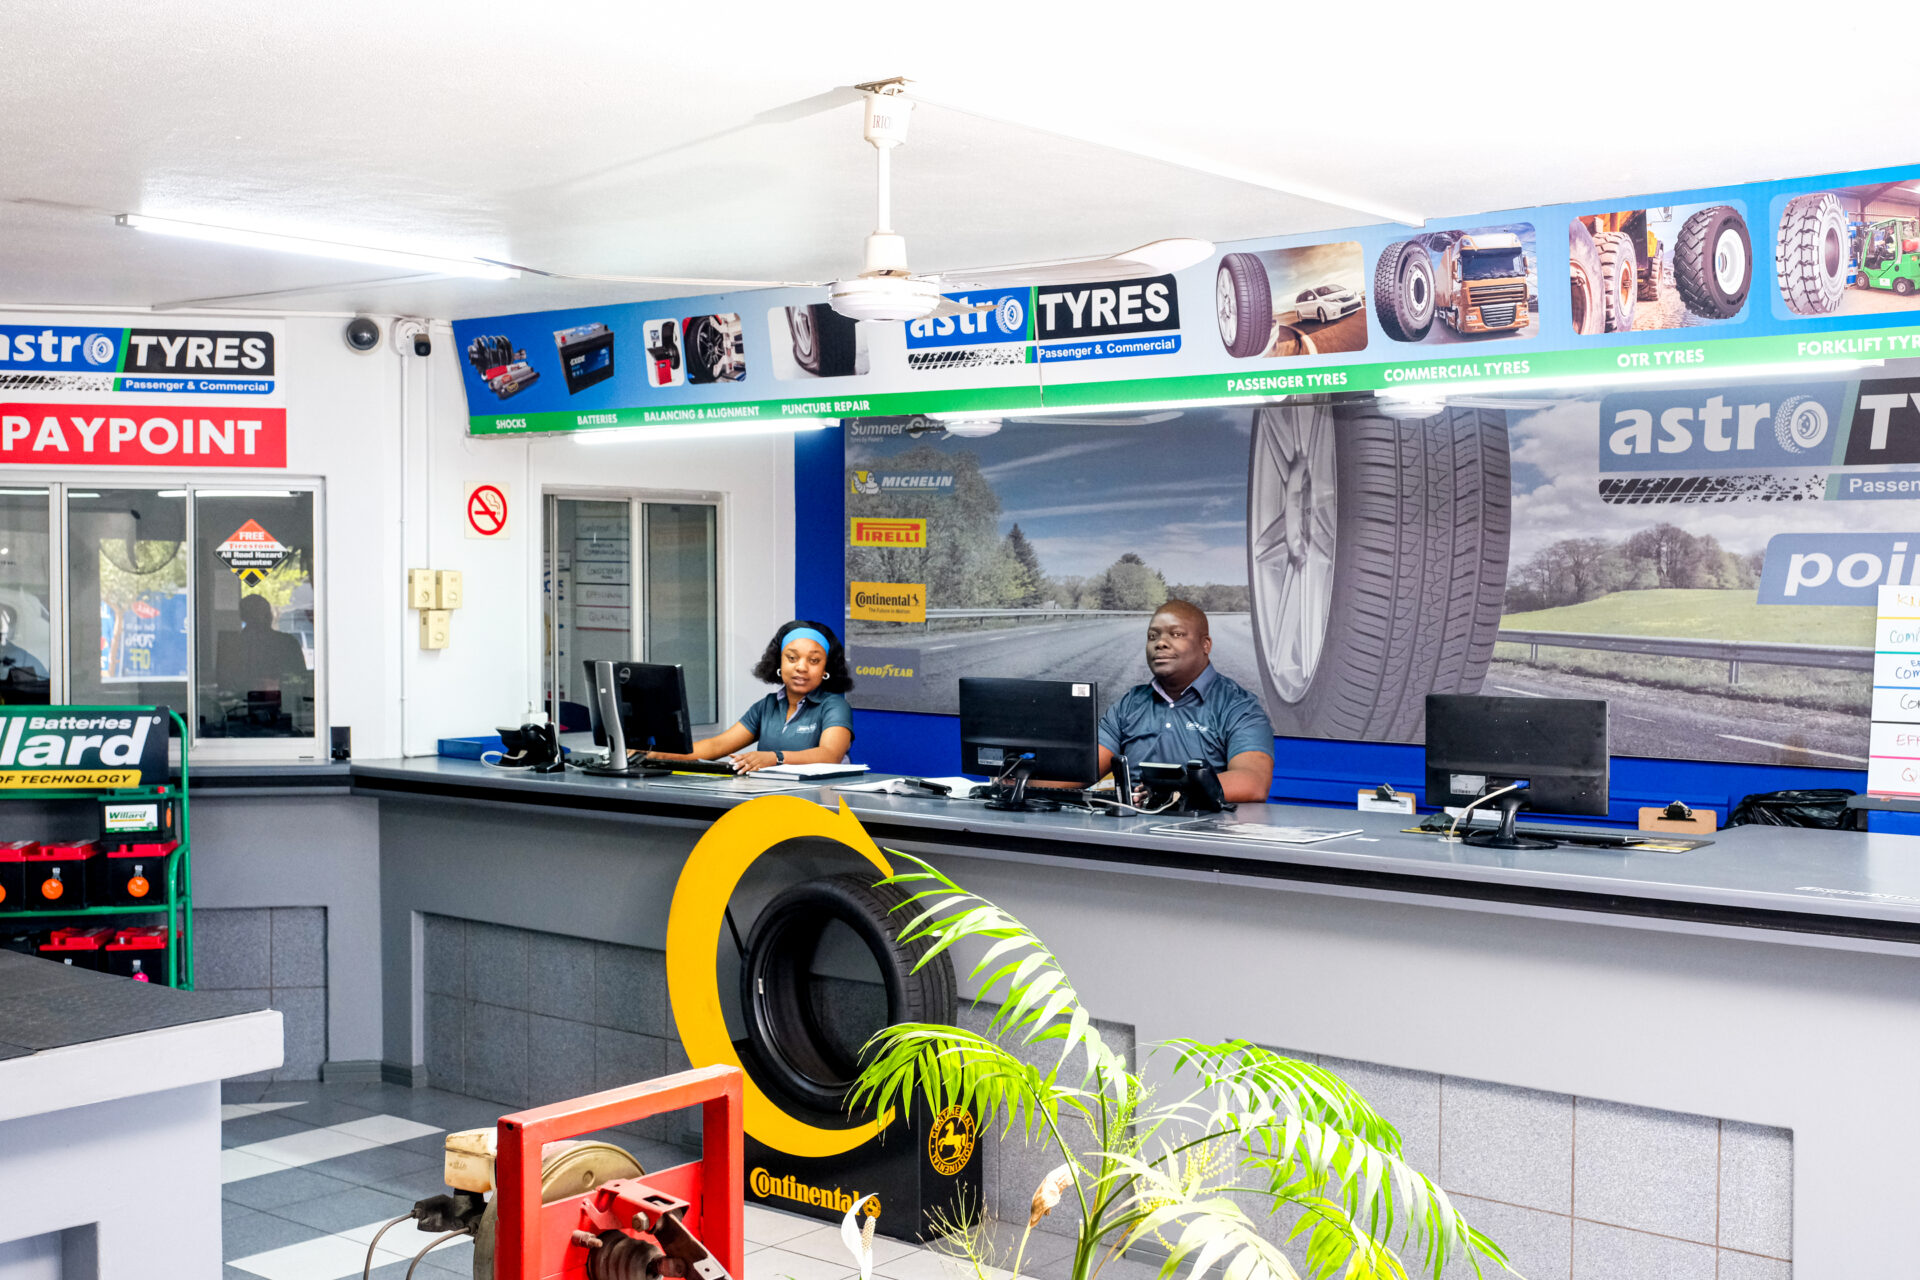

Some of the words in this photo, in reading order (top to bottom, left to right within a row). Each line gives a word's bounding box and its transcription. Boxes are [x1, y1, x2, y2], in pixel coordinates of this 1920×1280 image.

[1038, 283, 1170, 331] TYRES
[130, 334, 267, 370] TYRES
[1039, 345, 1092, 359] Passenger
[1095, 343, 1103, 354] &
[1107, 338, 1175, 354] Commercial
[1797, 336, 1883, 357] FORKLIFT
[1617, 352, 1650, 367] OTR
[1653, 349, 1704, 365] TYRES
[1384, 364, 1481, 382] COMMERCIAL
[1484, 360, 1530, 376] TYRES
[126, 380, 184, 392] Passenger
[187, 381, 196, 390] &
[200, 381, 268, 392] Commercial
[1227, 375, 1302, 392] PASSENGER
[1306, 372, 1347, 387] TYRES
[644, 409, 696, 422] BALANCING
[697, 409, 704, 418] &
[707, 406, 760, 419] ALIGNMENT
[781, 402, 832, 415] PUNCTURE
[834, 400, 870, 412] REPAIR
[495, 419, 527, 429] SHOCKS
[577, 413, 618, 425] BATTERIES
[1608, 394, 1829, 456] astro
[1, 415, 262, 455] PAYPOINT
[850, 420, 906, 436] Summer
[881, 476, 953, 487] MICHELIN
[239, 531, 265, 541] FREE
[856, 522, 920, 543] PIRELLI
[255, 551, 283, 559] Hazard
[855, 592, 910, 608] Continental
[856, 664, 914, 679] GOODYEAR
[29, 716, 132, 730] Batteries
[21, 774, 132, 784] TECHNOLOGY
[109, 810, 147, 819] Willard
